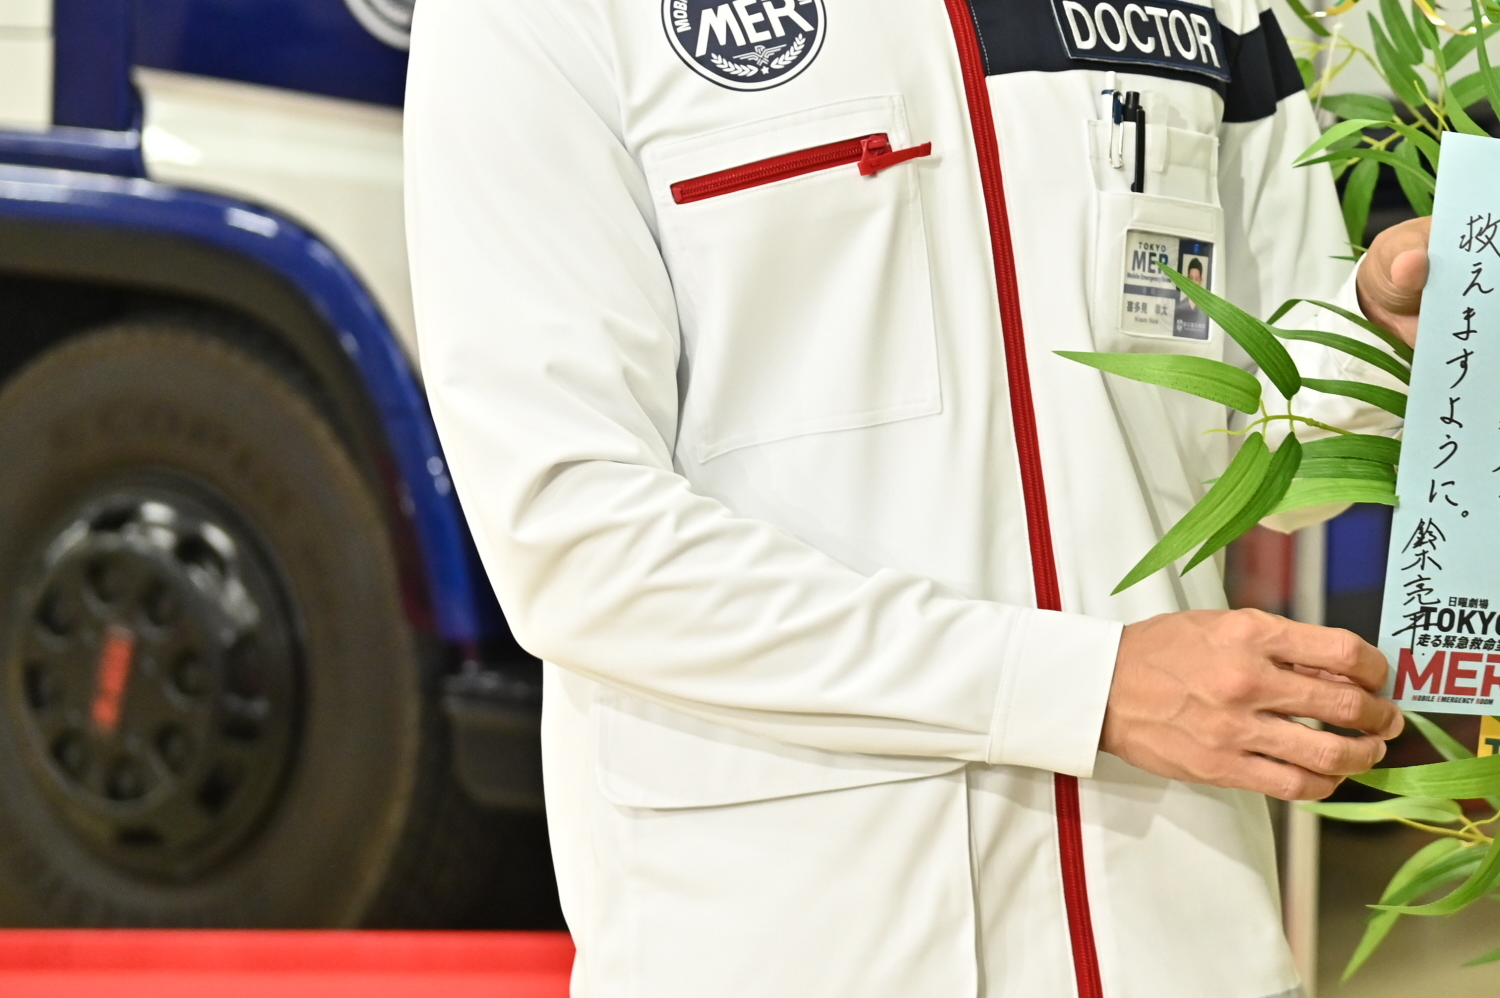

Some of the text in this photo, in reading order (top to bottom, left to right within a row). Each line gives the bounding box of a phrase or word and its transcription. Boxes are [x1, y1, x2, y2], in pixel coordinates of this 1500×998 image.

[1062, 0, 1221, 69] DOCTOR
[1138, 241, 1166, 253] TOKYO
[1448, 596, 1489, 609] 日曜劇場
[1437, 696, 1474, 704] EMERGENCY
